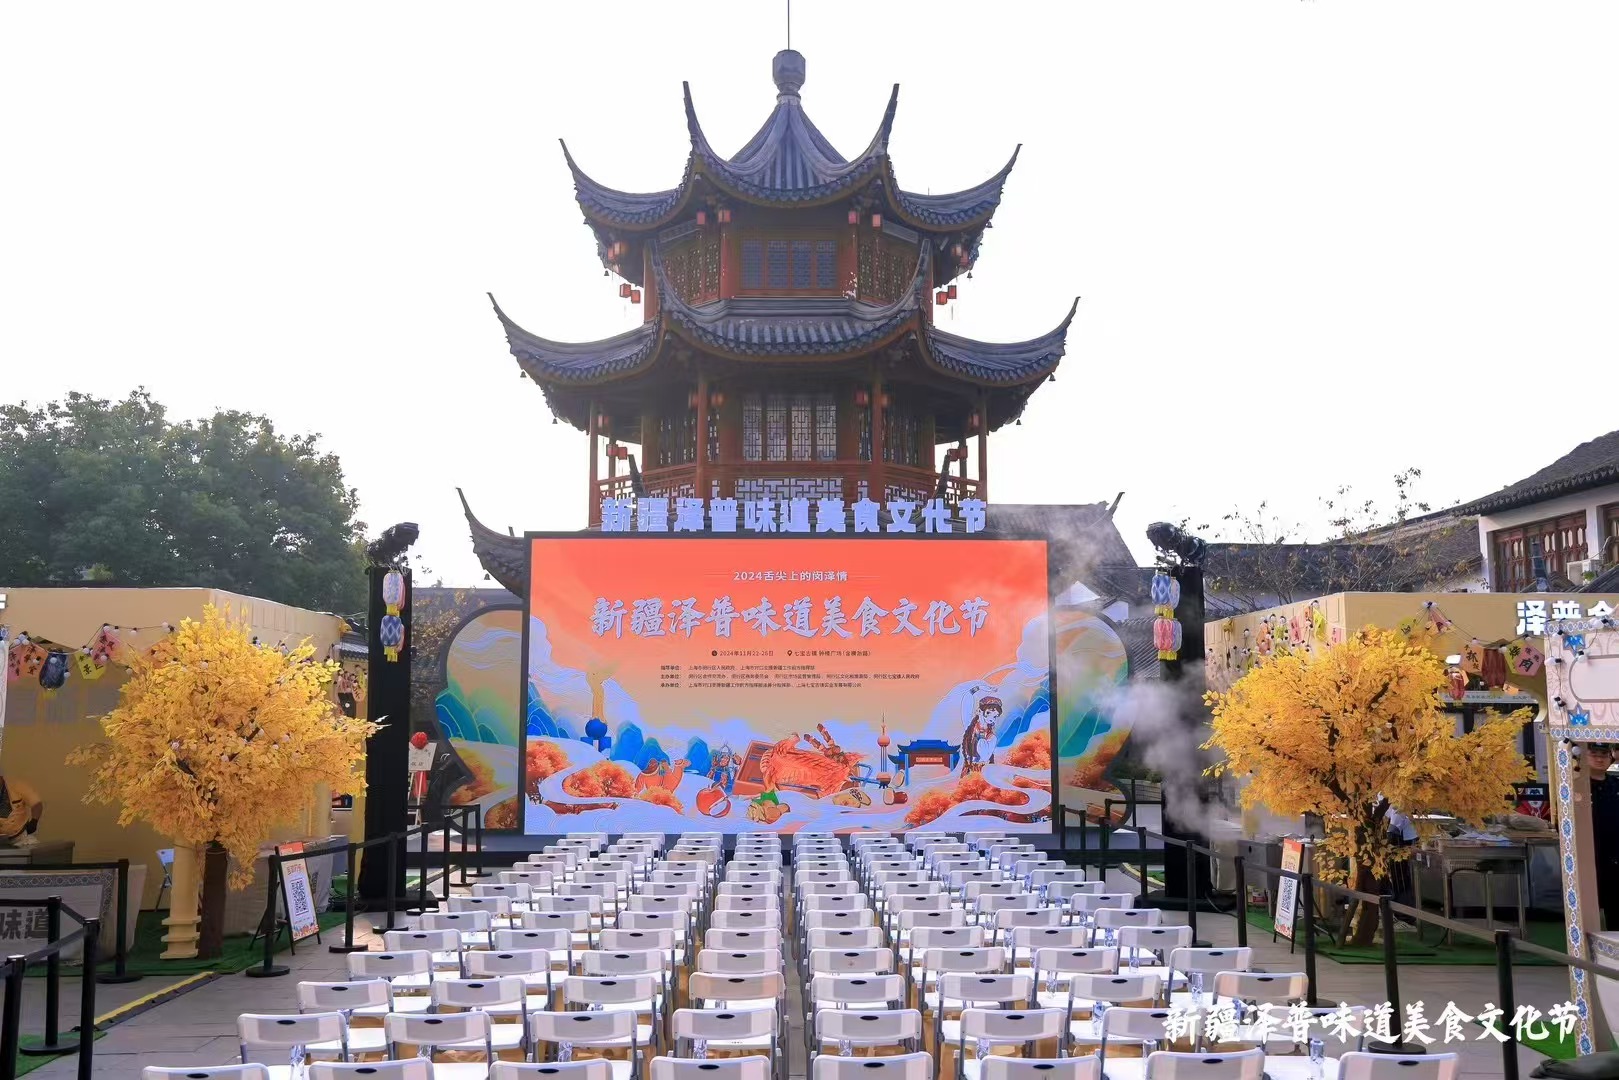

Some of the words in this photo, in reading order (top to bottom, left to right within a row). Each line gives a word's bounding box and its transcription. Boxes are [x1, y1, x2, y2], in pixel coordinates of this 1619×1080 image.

[601, 498, 987, 533] 新疆泽普味道美食文化节
[733, 570, 848, 582] 2024舌尖上的闵泽情
[590, 595, 990, 640] 新疆泽普味道美食文化节
